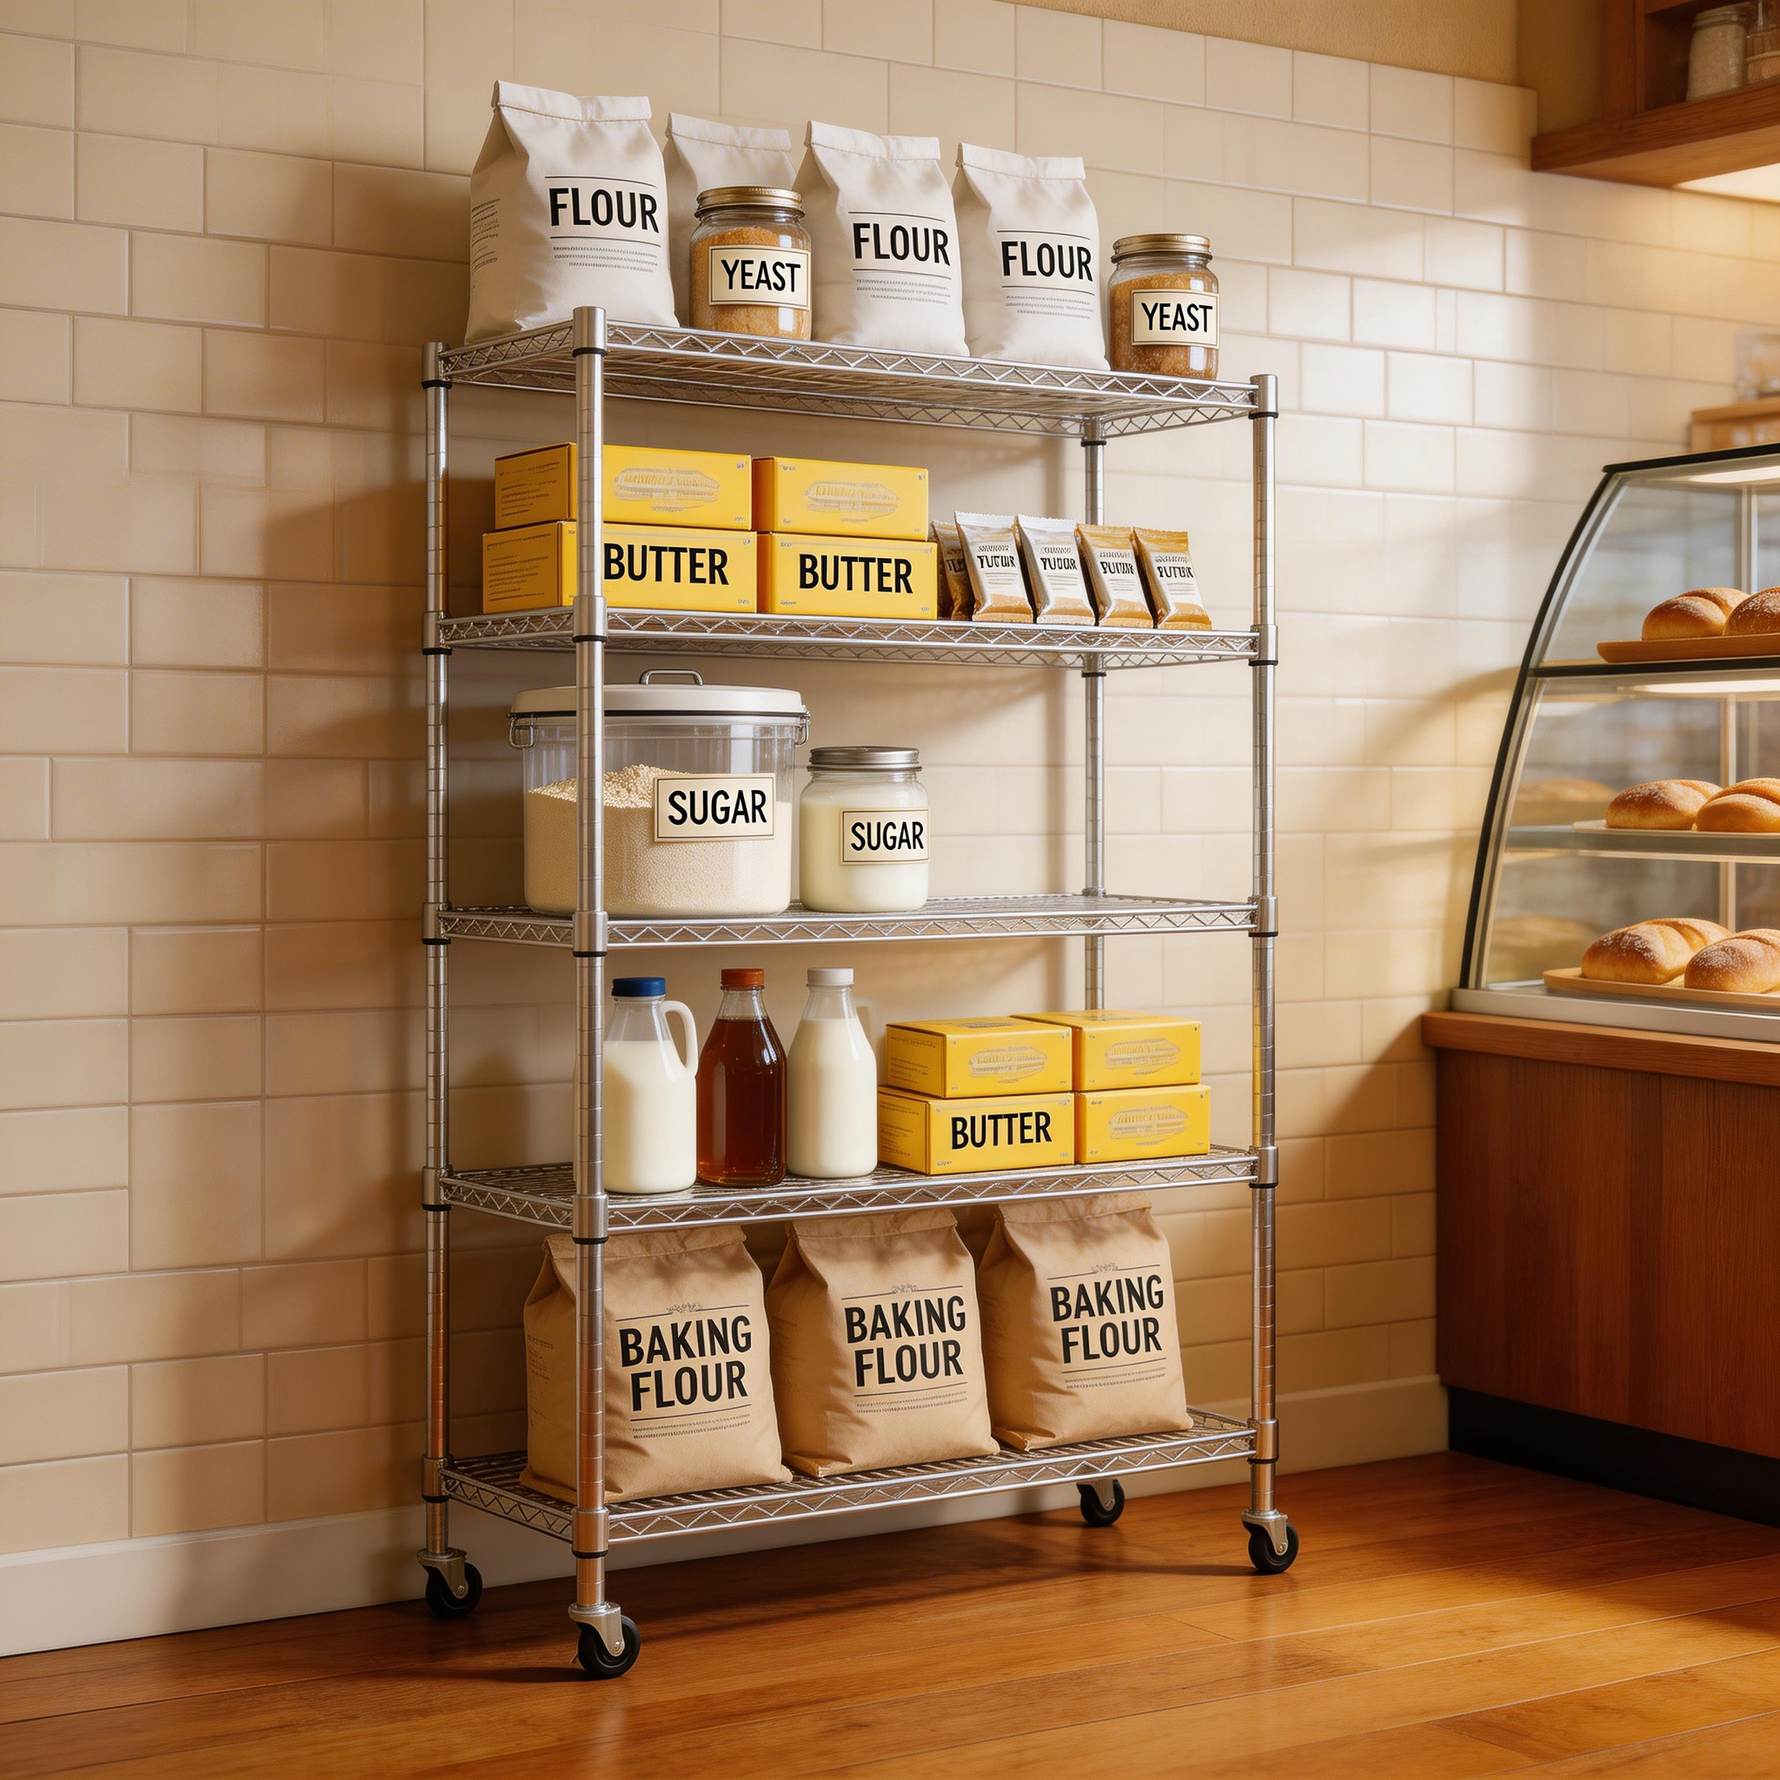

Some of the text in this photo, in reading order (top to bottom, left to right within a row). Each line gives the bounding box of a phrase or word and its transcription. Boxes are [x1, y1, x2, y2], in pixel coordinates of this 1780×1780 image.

[548, 187, 660, 234] FLOUR
[852, 222, 951, 266] FLOUR
[1001, 240, 1094, 282] FLOUR
[720, 259, 801, 293] YEAST
[1140, 302, 1213, 333] YEAST
[603, 542, 729, 586] BUTTER
[799, 553, 914, 594] BUTTER
[667, 789, 768, 826] SUGAR
[850, 821, 924, 851] SUGAR
[951, 1111, 1053, 1150] BUTTER
[844, 1295, 967, 1344] BAKING
[1049, 1274, 1165, 1322] BAKING
[618, 1315, 752, 1368] BAKING
[1060, 1317, 1163, 1364] FLOUR
[854, 1339, 964, 1387] FLOUR
[630, 1360, 749, 1412] FLOUR
